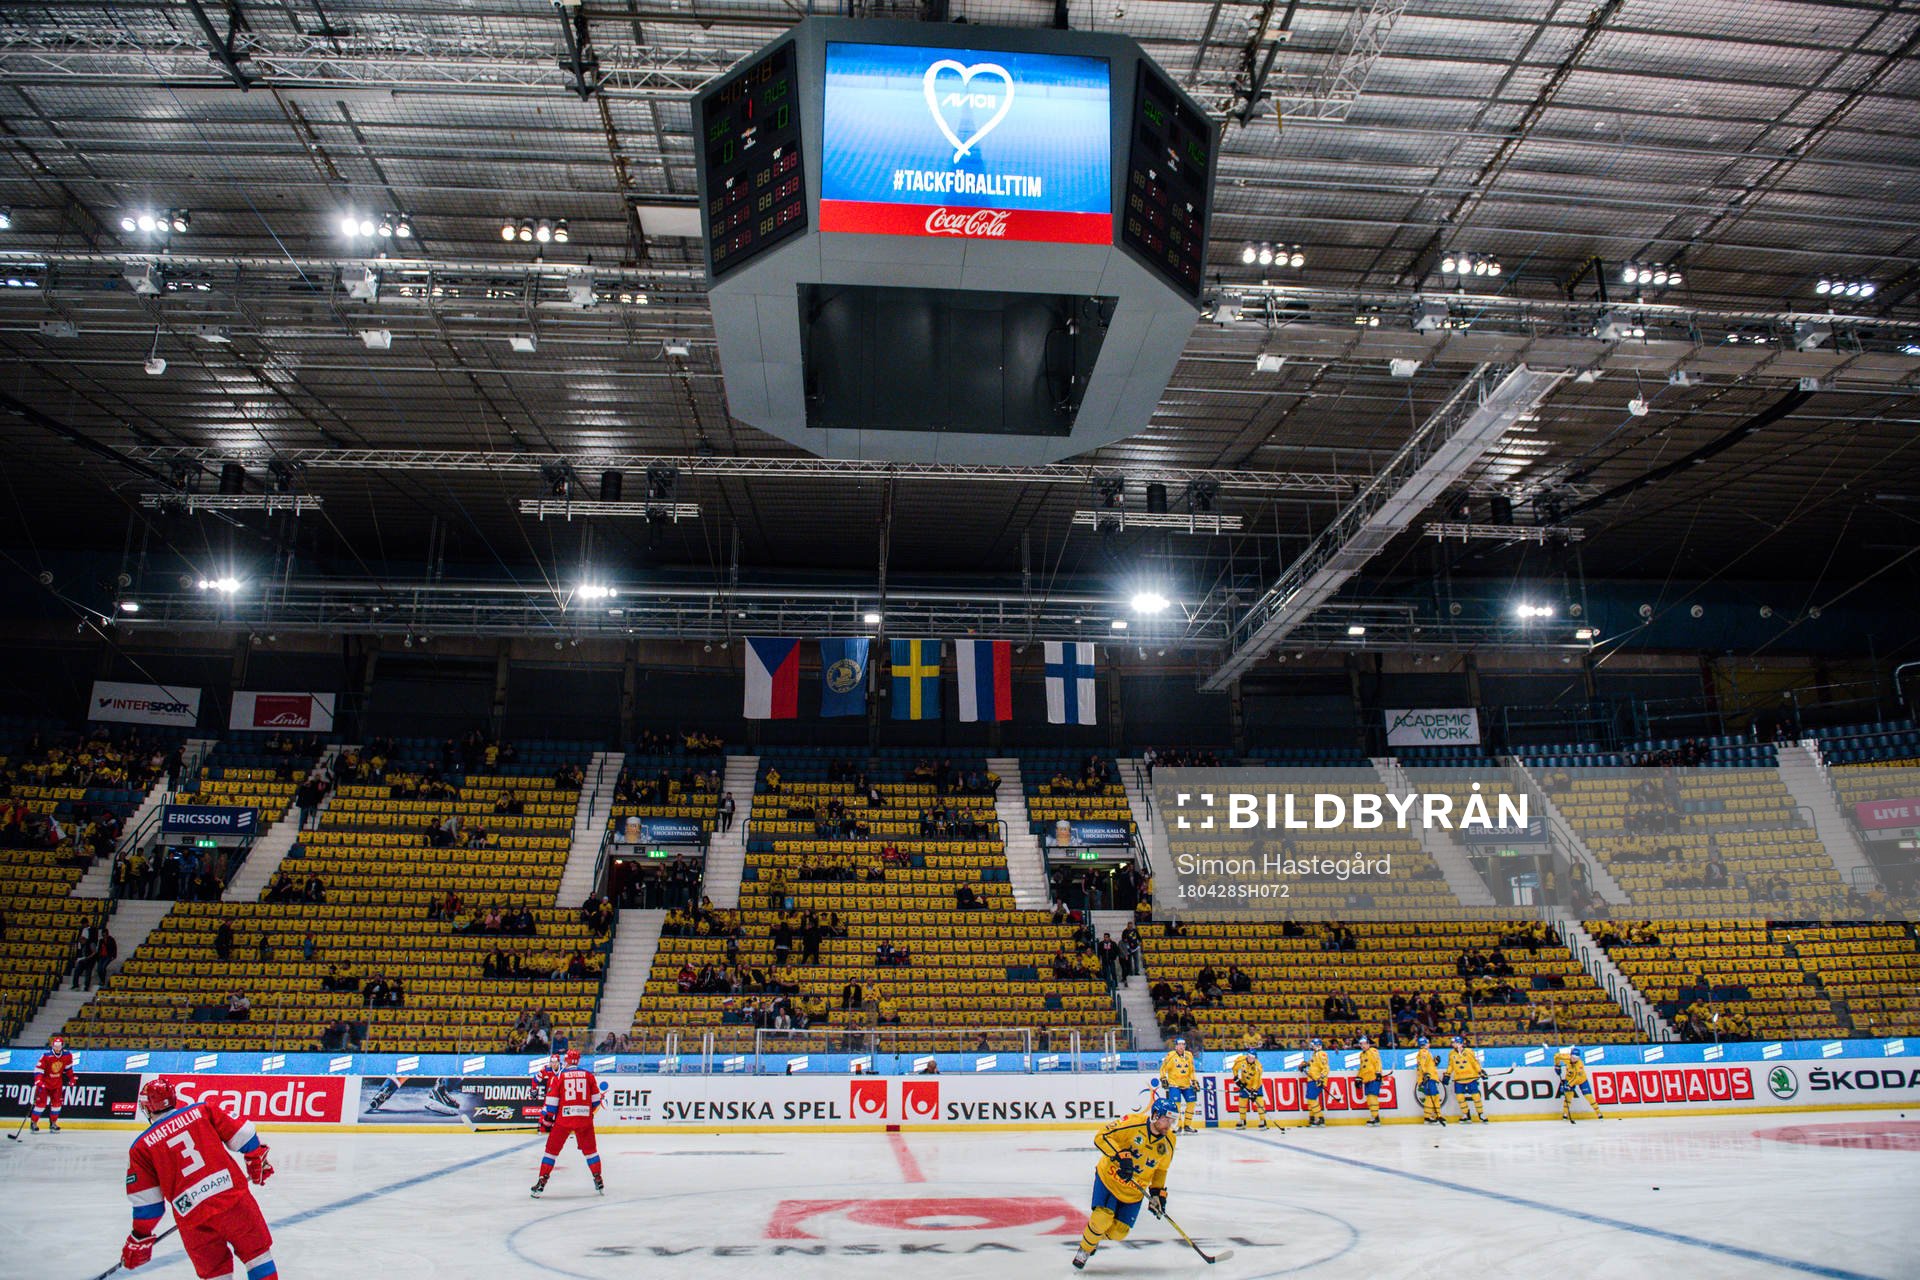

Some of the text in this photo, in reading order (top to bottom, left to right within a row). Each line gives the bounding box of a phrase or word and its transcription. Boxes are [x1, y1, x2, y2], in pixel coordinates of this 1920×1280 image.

[893, 169, 1042, 198] #TACKFÖRALLTTIM
[924, 207, 1012, 236] Coca-Cola
[113, 698, 190, 714] INTERSPORT
[264, 712, 310, 726] Linde
[1393, 714, 1472, 727] ACADEMIC
[1421, 727, 1473, 740] WORK.
[168, 813, 231, 826] ERICSSON
[1873, 806, 1910, 820] LIVE
[1596, 1072, 1749, 1098] BAUHAUS
[1808, 1067, 1920, 1091] ŠKODA
[5, 1084, 19, 1098] TO
[18, 1085, 106, 1107] DONATE
[175, 1081, 327, 1119] Scandic
[484, 1085, 546, 1100] DOMINAE
[564, 1079, 587, 1101] 89
[613, 1090, 652, 1106] EHT
[1228, 1079, 1394, 1106] BAUAUS
[662, 1101, 841, 1120] SVENSKA SPEL
[947, 1100, 1121, 1120] SVENSKA SPEL
[144, 1108, 202, 1147] KHAFIZULLIN
[166, 1130, 206, 1178] 3
